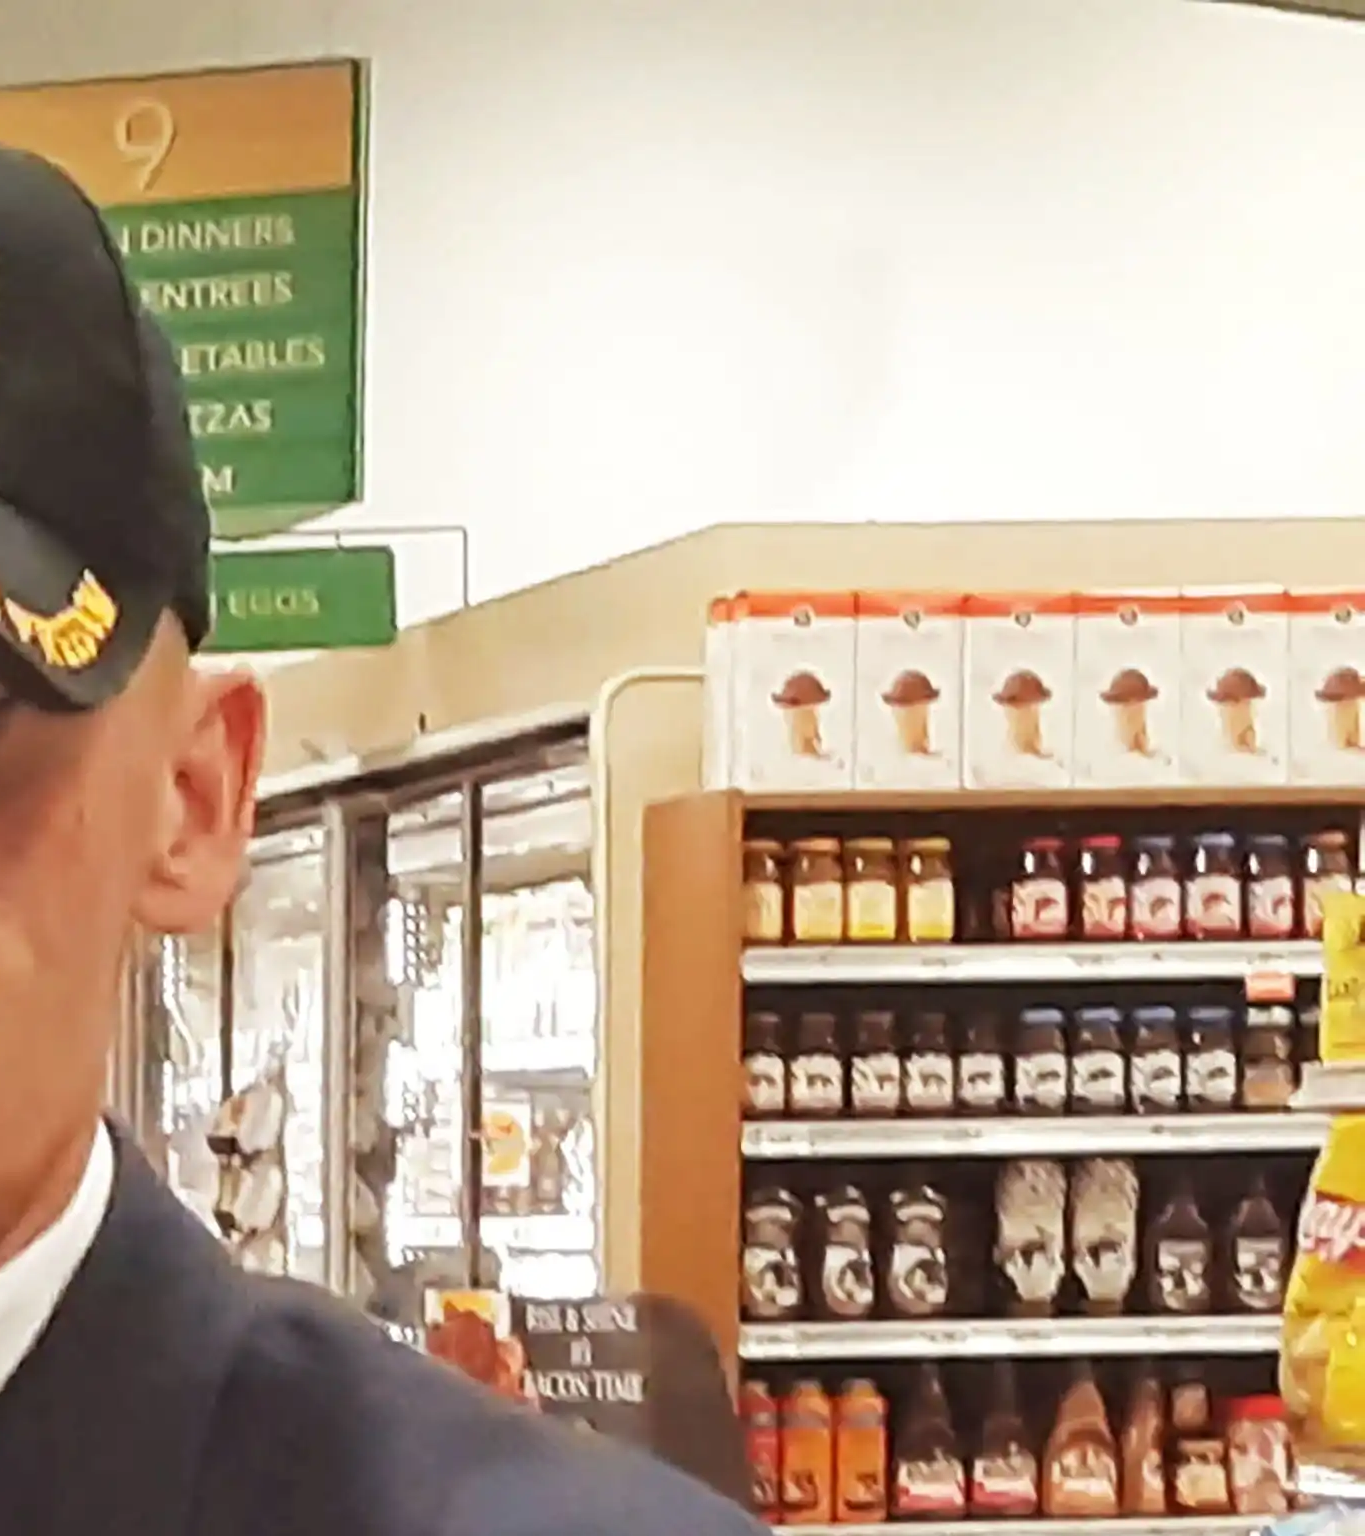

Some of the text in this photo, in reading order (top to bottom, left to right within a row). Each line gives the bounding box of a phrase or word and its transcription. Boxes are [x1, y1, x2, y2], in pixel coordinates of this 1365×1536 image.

[114, 99, 173, 192] 9
[140, 213, 295, 253] DINNERS
[180, 334, 325, 376] ETABLES
[187, 398, 272, 439] ZZAS
